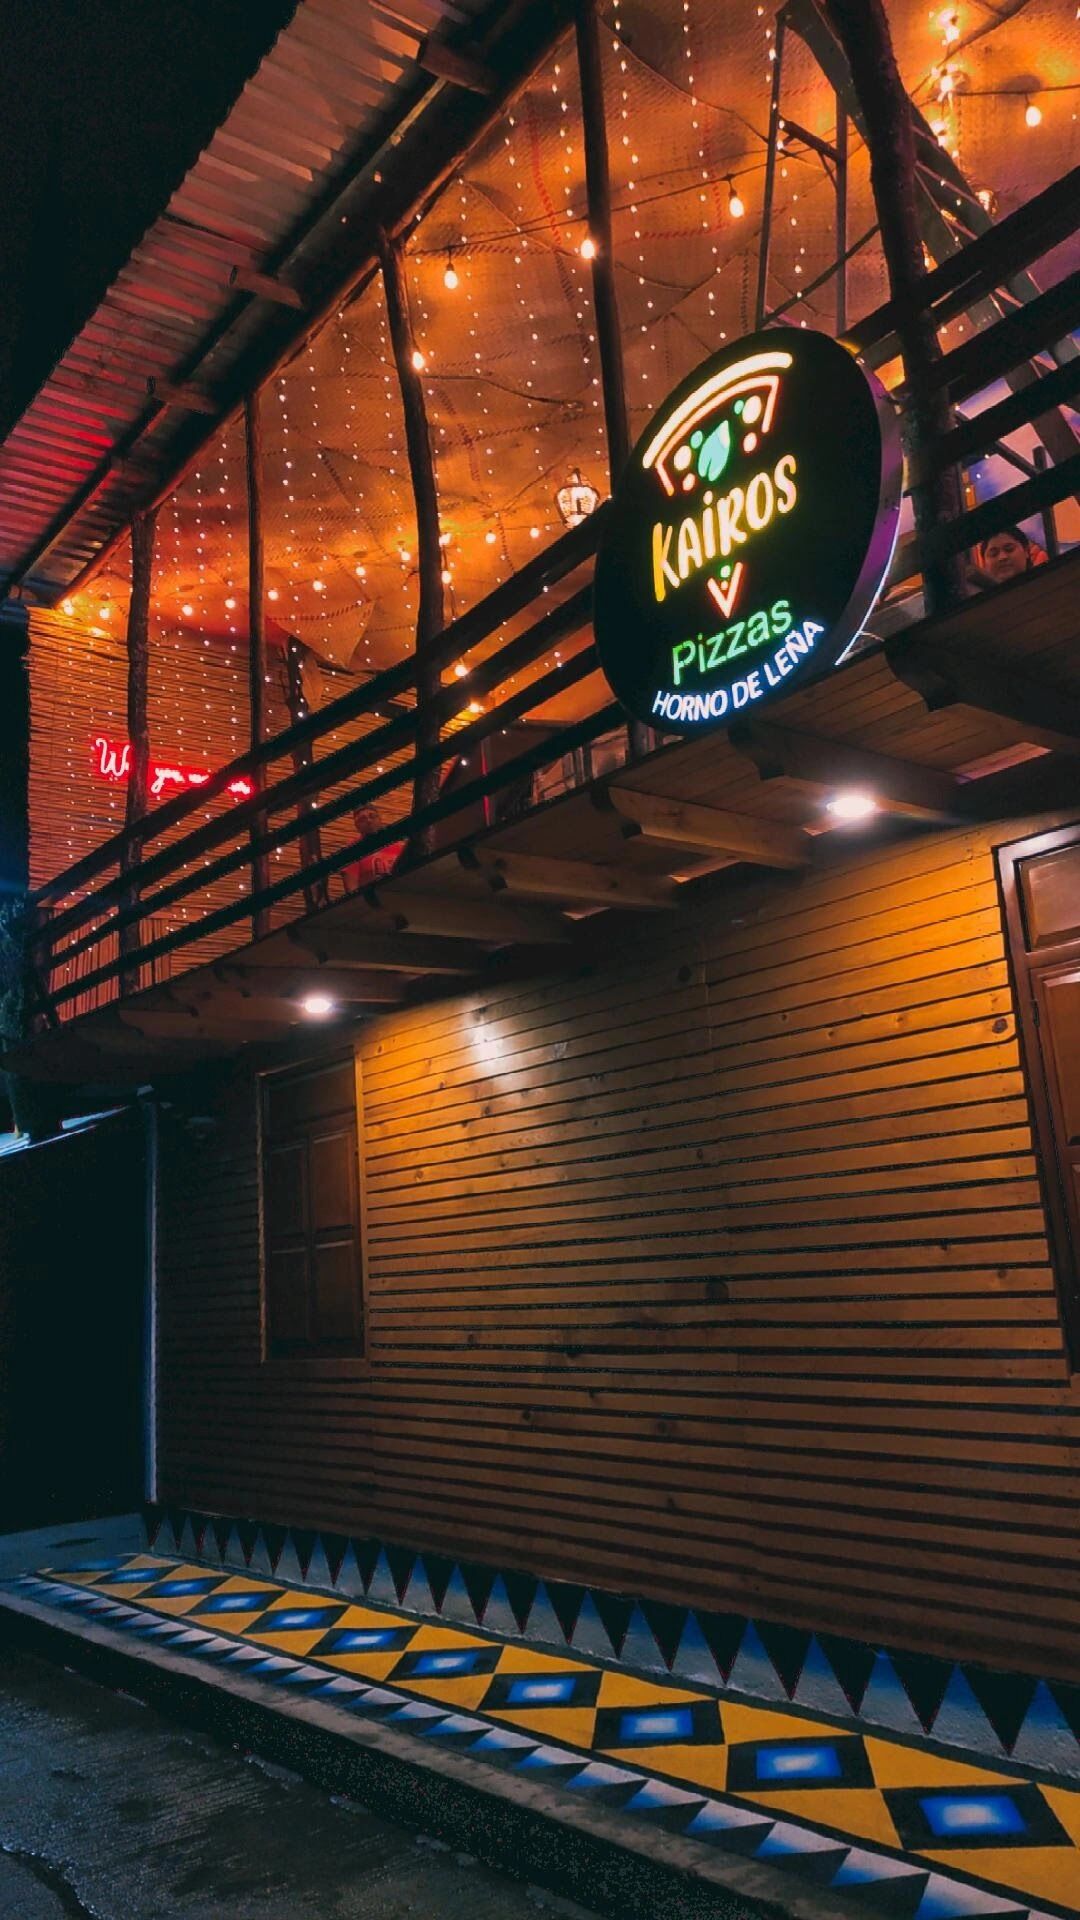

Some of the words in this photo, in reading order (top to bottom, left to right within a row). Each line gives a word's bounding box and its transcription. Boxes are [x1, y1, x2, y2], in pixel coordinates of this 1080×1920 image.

[652, 690, 728, 721] HORNO
[731, 671, 763, 709] DE
[764, 621, 825, 686] LEÑA
[672, 600, 792, 685] Pizzas
